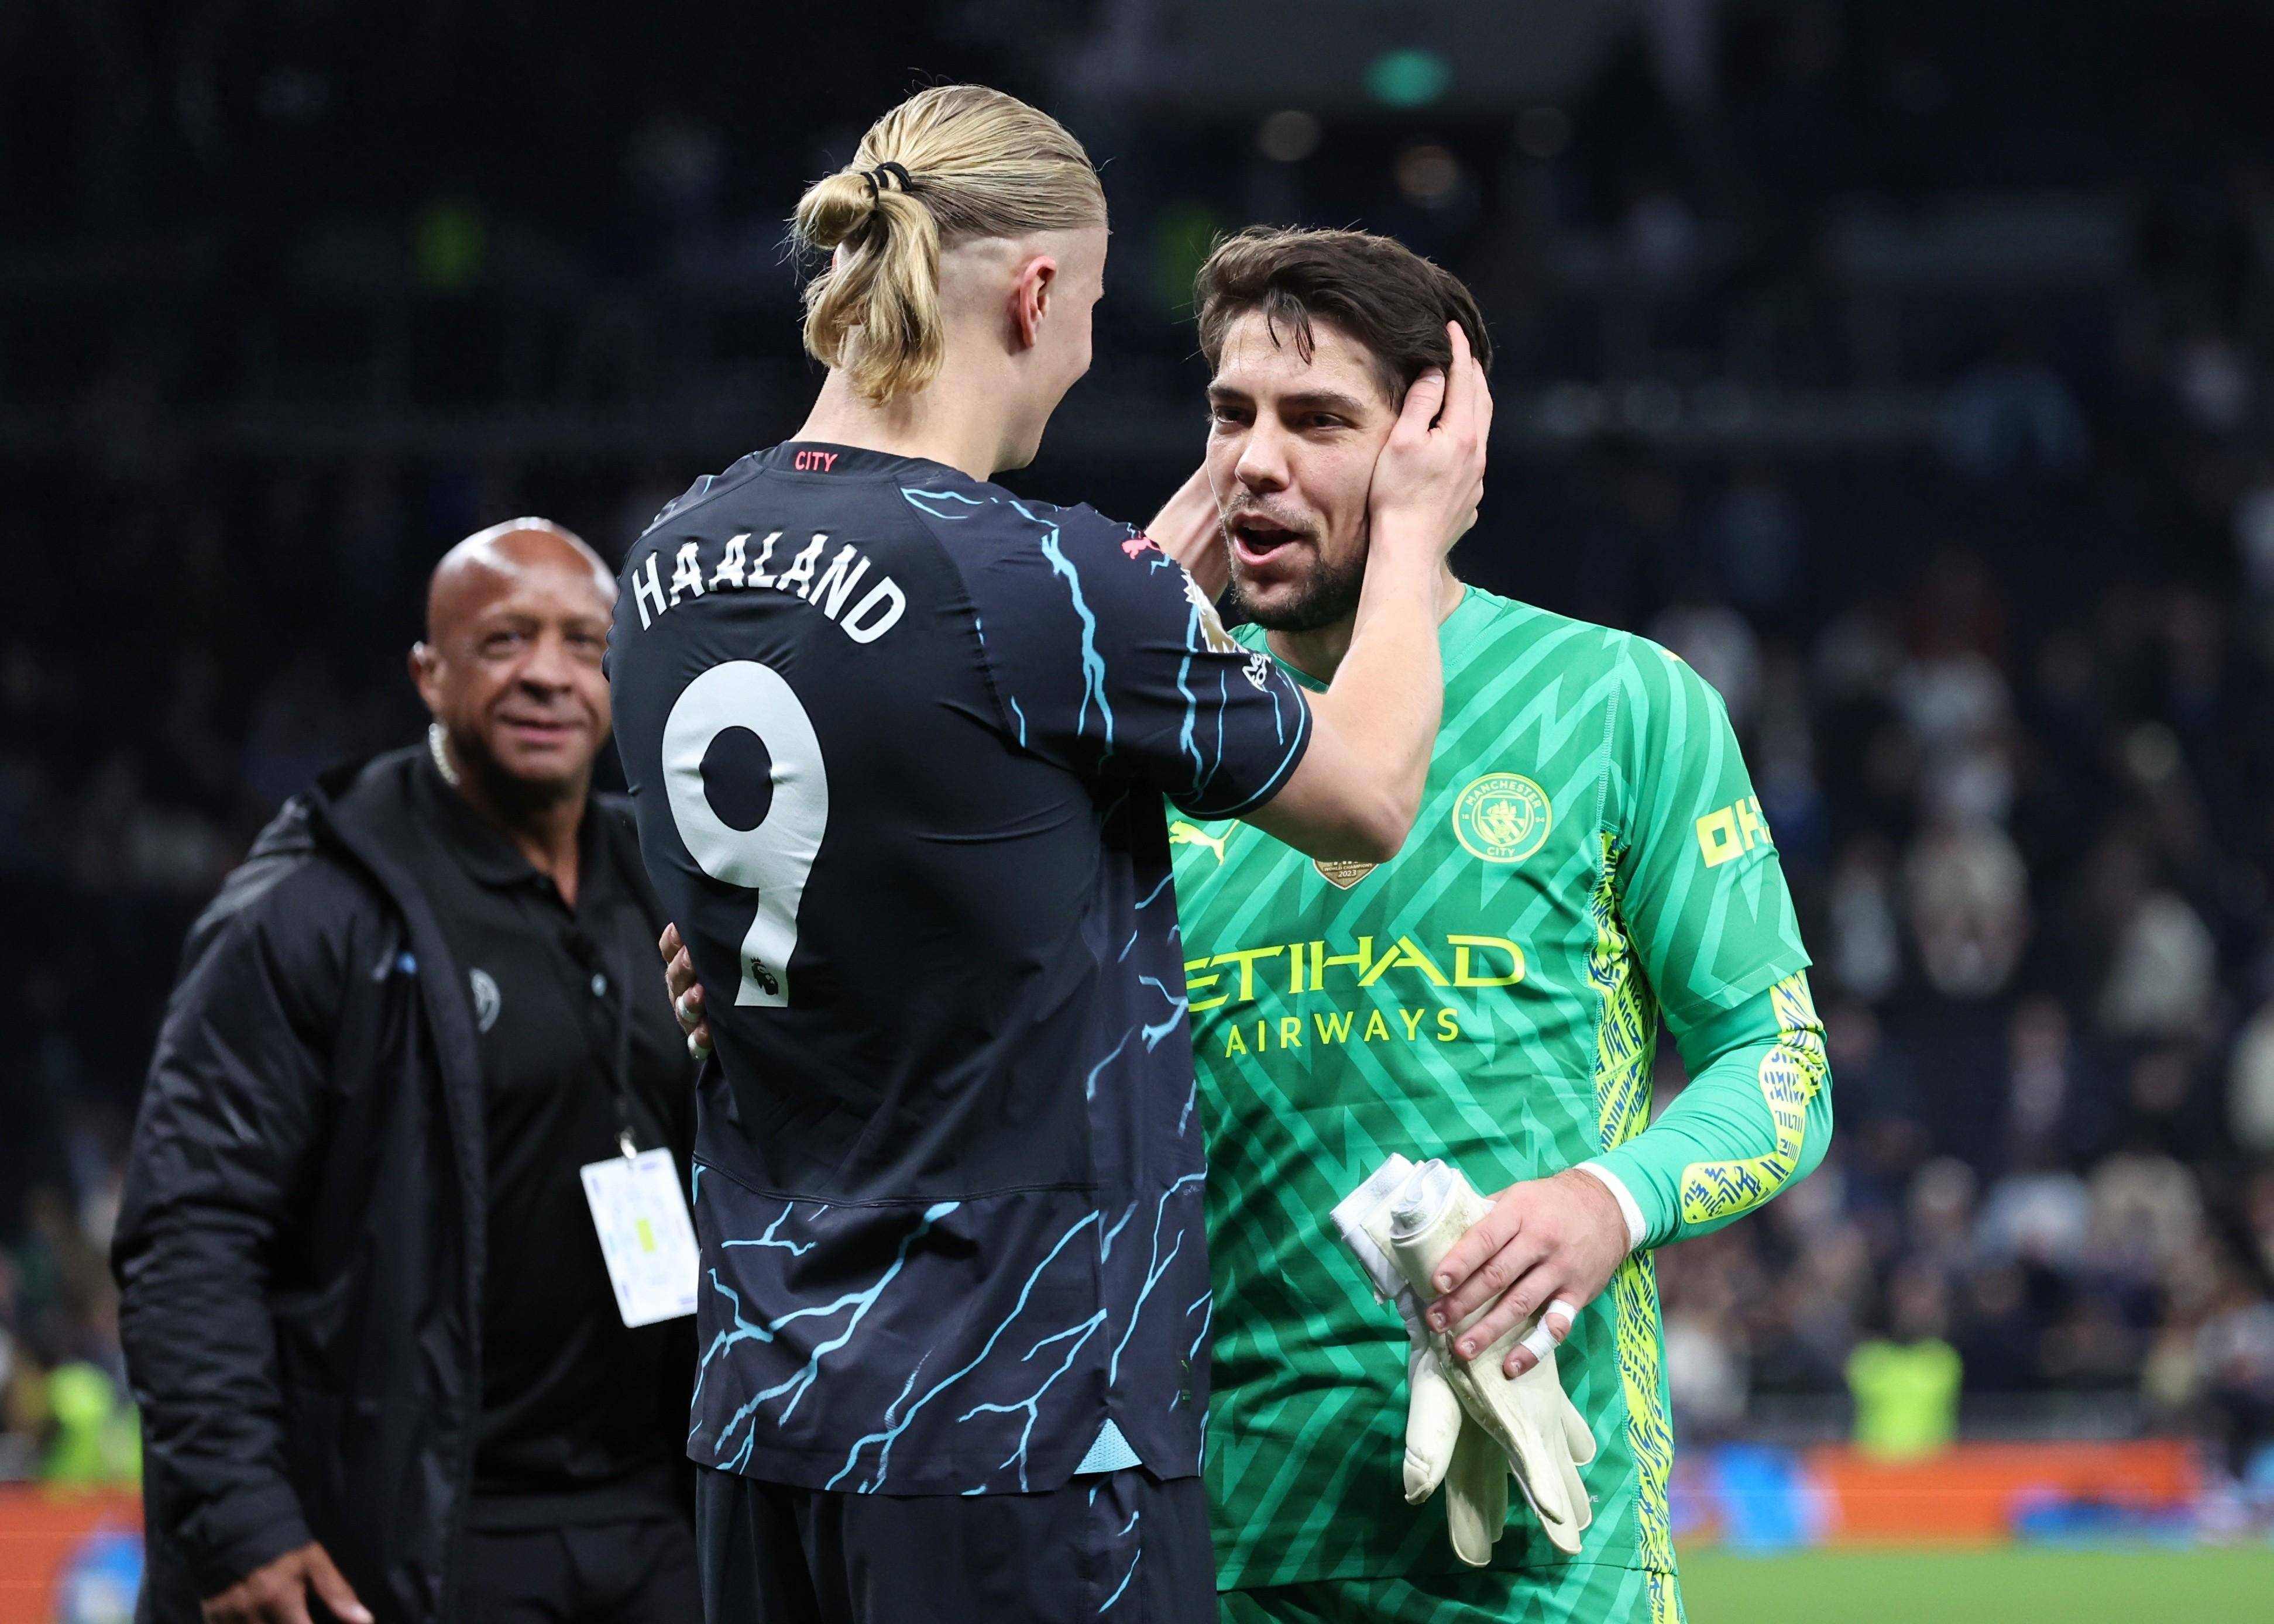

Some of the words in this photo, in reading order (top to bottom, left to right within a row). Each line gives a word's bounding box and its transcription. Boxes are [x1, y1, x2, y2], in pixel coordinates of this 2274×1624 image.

[795, 450, 839, 472] CITY
[632, 531, 906, 644] HAALAND
[1465, 780, 1542, 808] MANCHESTER
[662, 660, 829, 1007] 9
[1487, 848, 1515, 856] CITY
[1338, 869, 1357, 878] 2023
[1184, 934, 1526, 1013] ETIHAD
[1225, 1007, 1459, 1058] AIRWAYS
